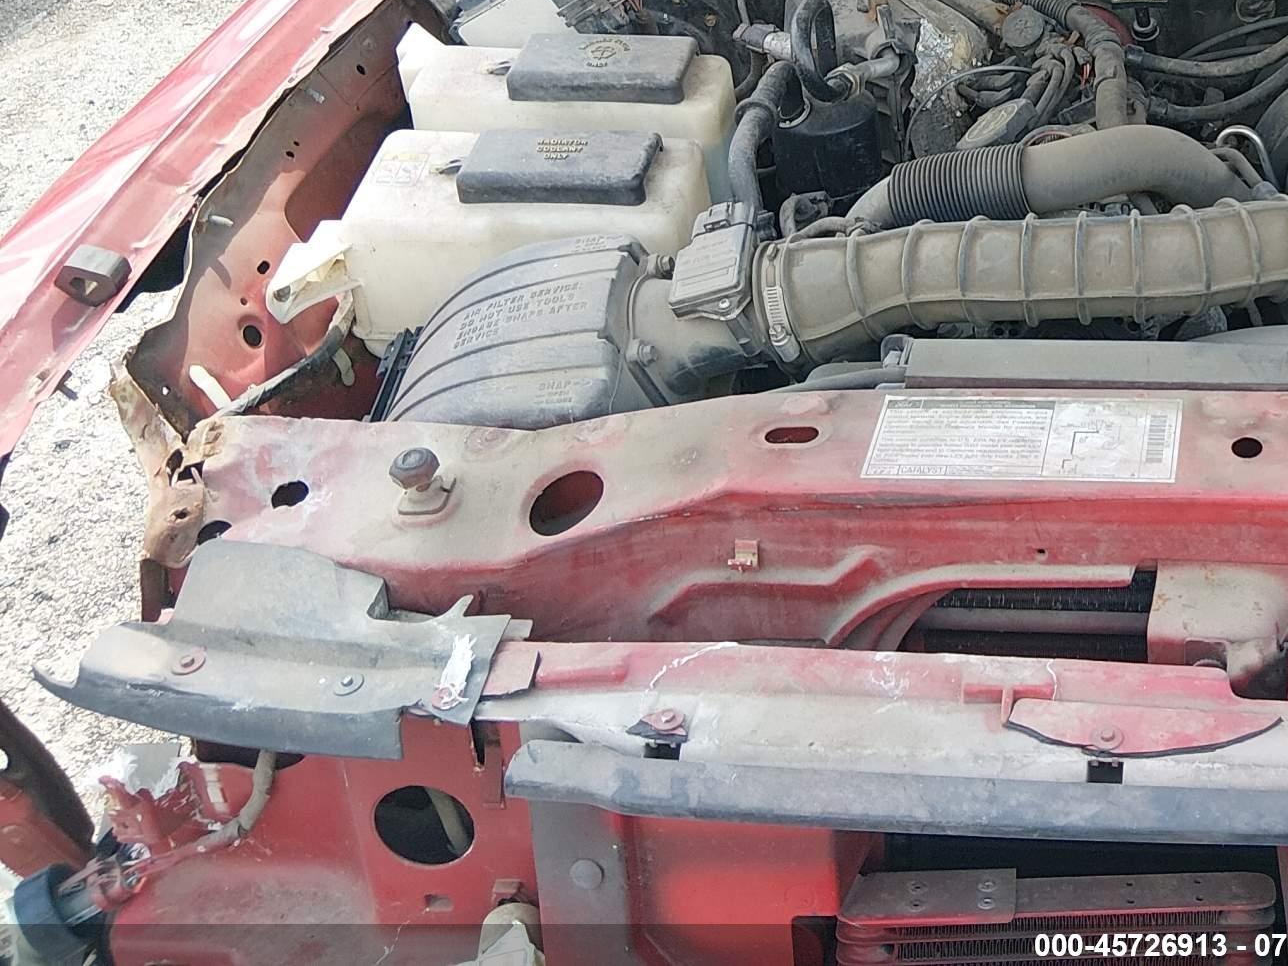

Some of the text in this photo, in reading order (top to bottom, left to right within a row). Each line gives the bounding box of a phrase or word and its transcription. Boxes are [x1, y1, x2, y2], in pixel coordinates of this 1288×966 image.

[536, 145, 583, 153] COOLANT
[543, 152, 569, 160] ONLY
[459, 292, 576, 331] DO NOT USE TOOLS
[463, 307, 482, 321] AIR
[485, 294, 525, 312] FILTER
[455, 318, 502, 341] ENGAGE
[548, 301, 589, 315] AFTER
[453, 328, 499, 349] SERVICE
[901, 466, 943, 474] CATALYST
